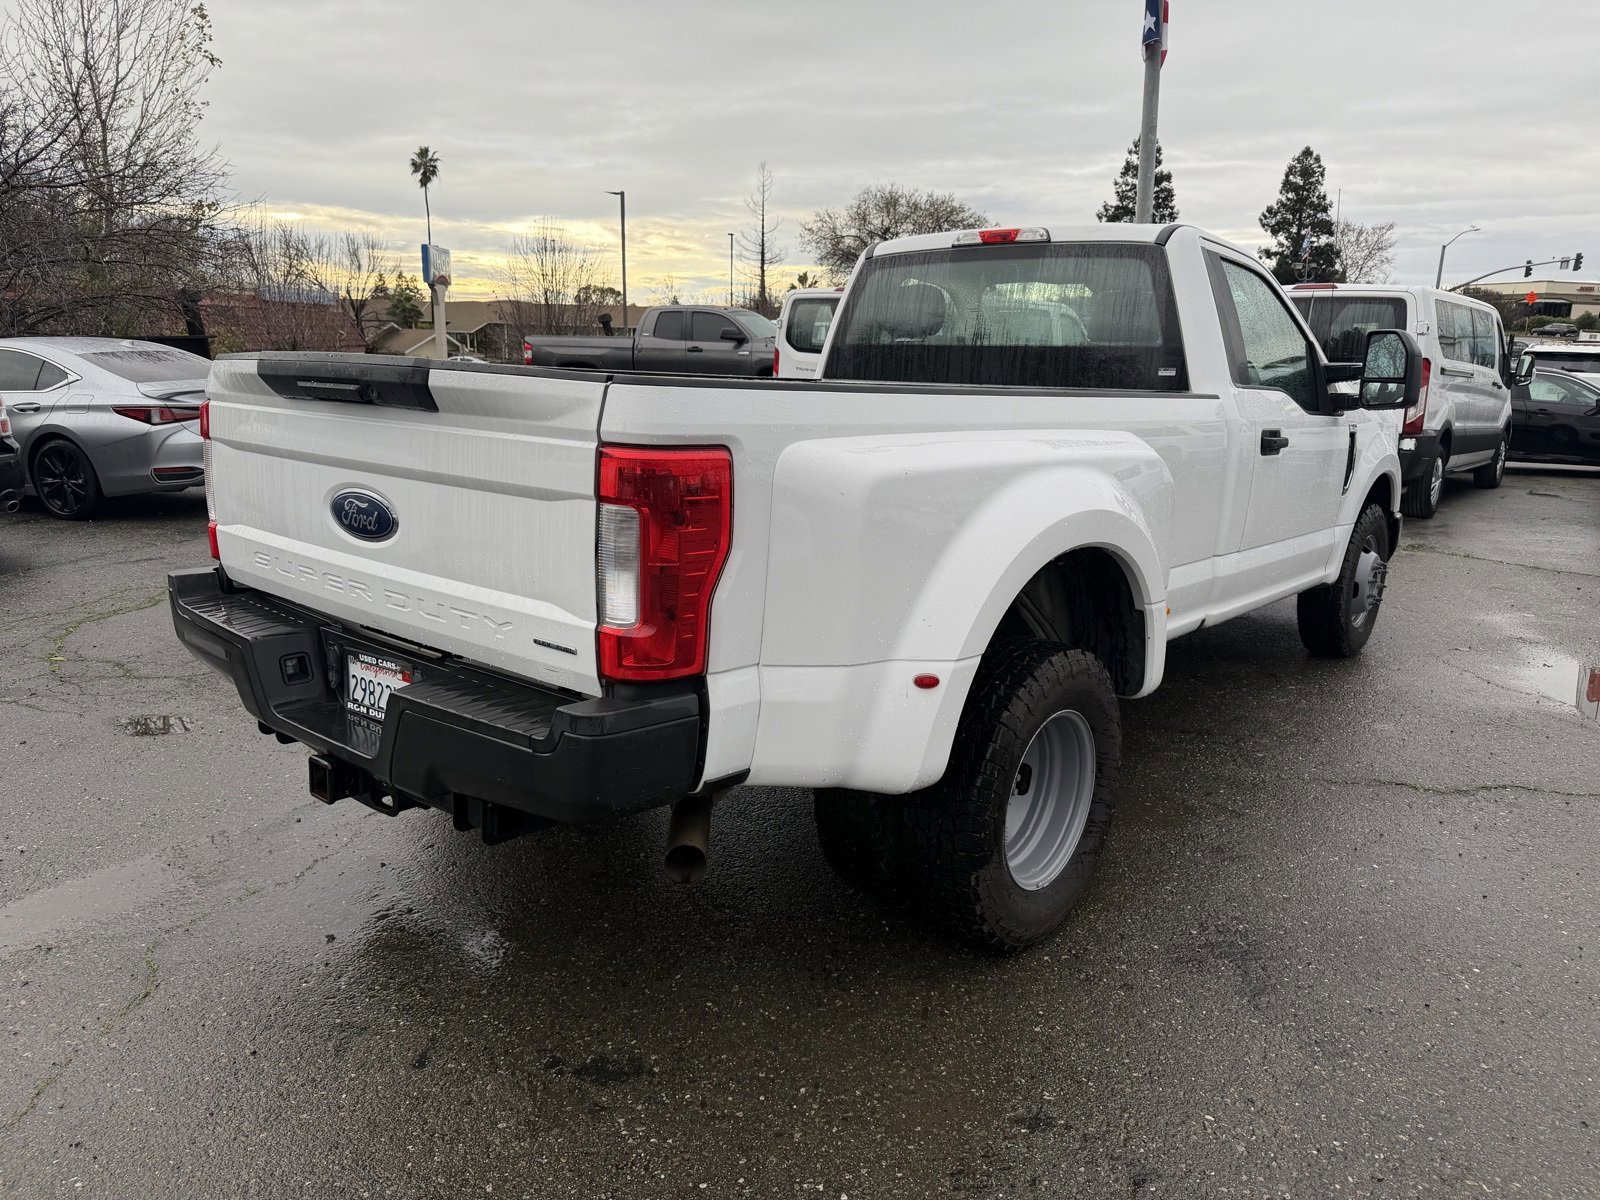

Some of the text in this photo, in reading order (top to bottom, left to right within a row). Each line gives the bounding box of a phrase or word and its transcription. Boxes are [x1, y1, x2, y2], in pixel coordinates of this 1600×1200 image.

[341, 498, 378, 531] Ford
[254, 551, 513, 639] SUPER DUTY
[358, 653, 377, 665] USED
[377, 659, 397, 670] CARS
